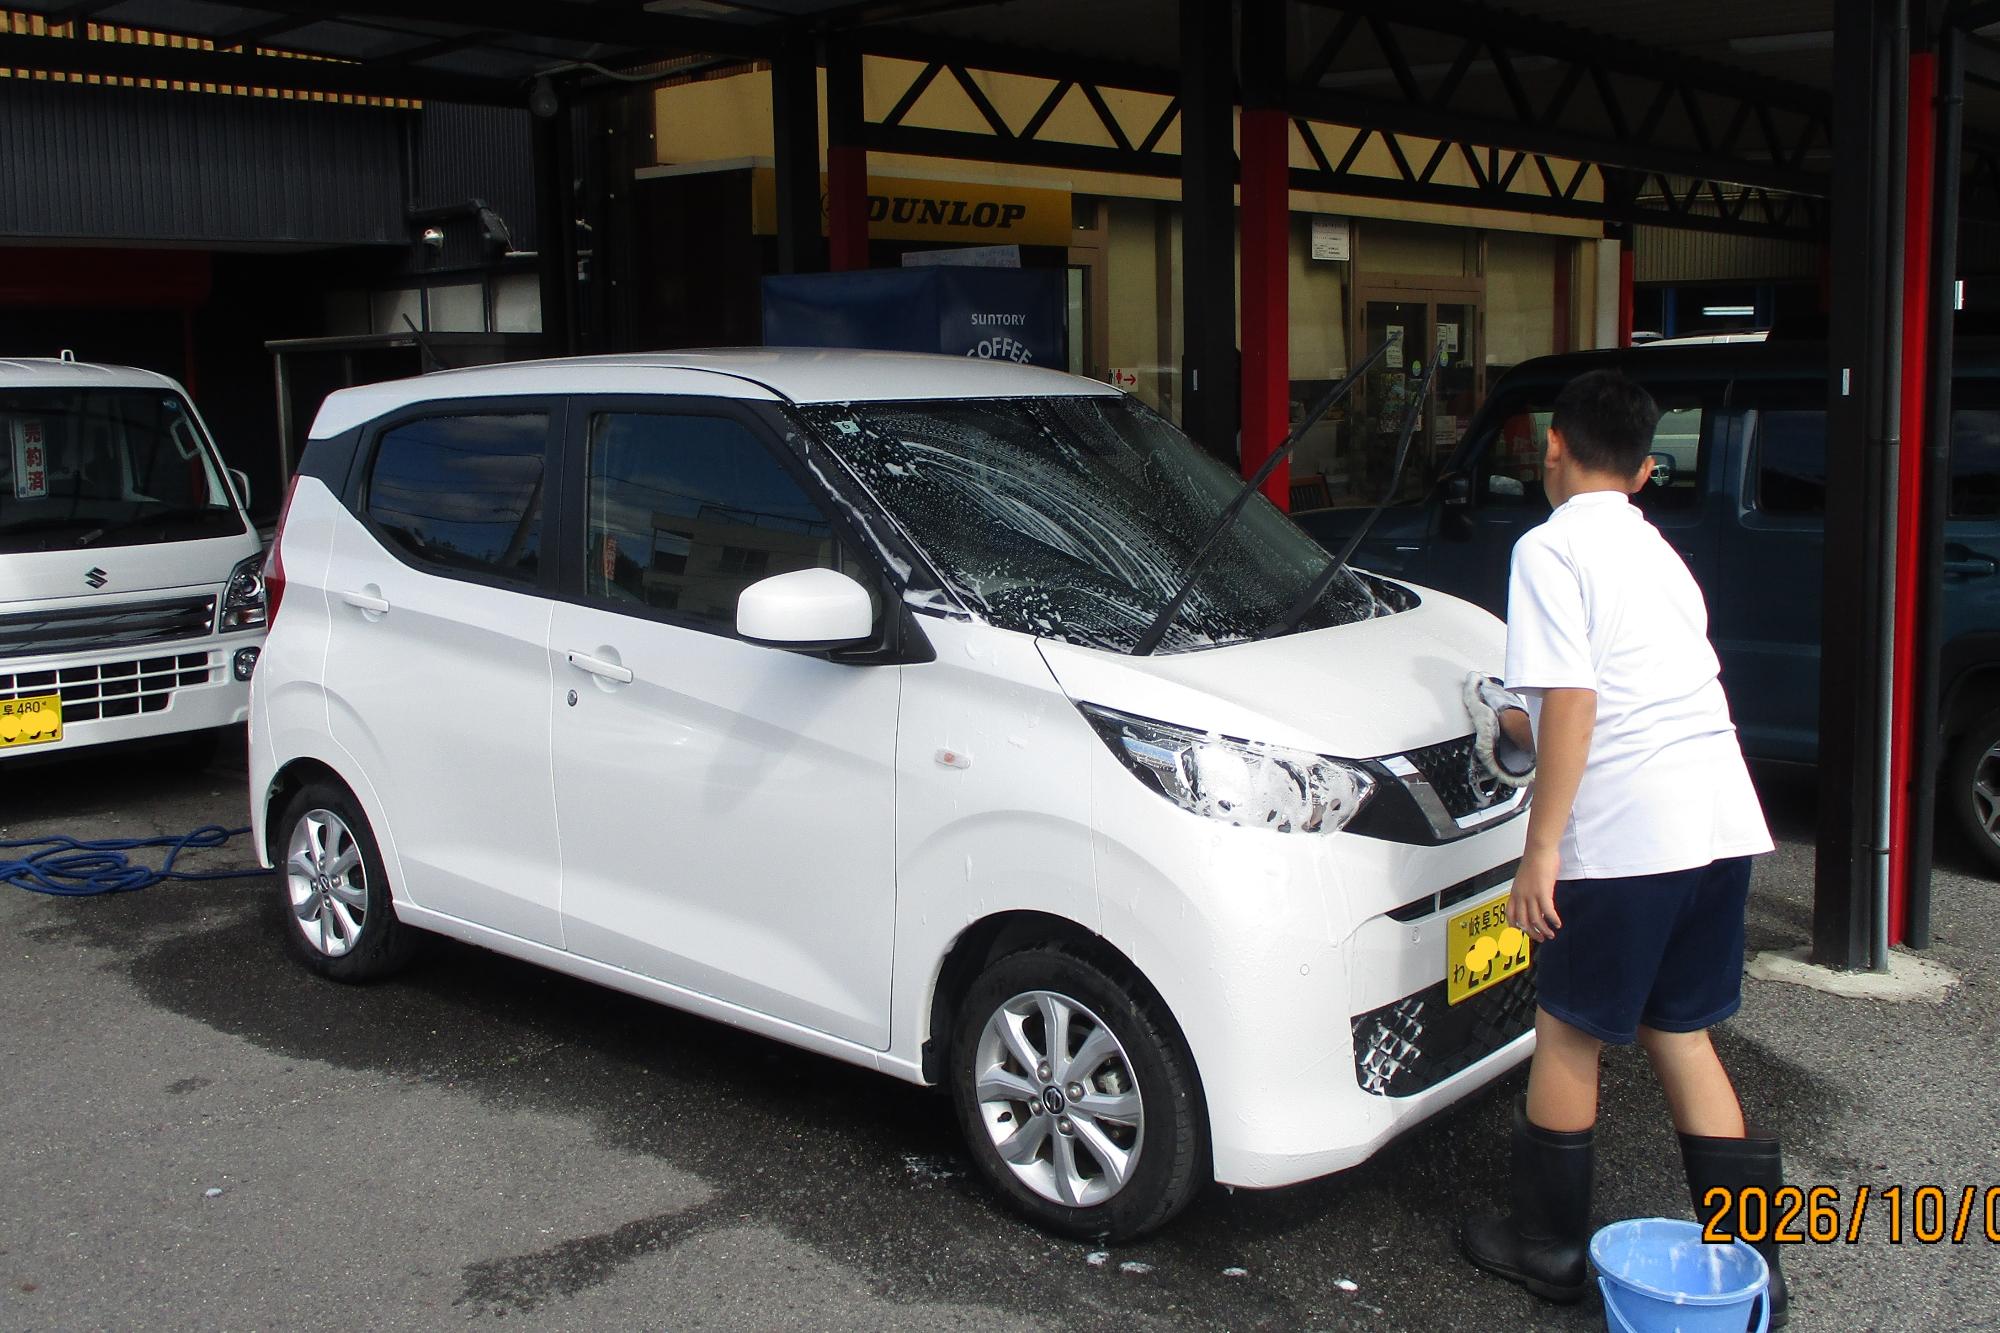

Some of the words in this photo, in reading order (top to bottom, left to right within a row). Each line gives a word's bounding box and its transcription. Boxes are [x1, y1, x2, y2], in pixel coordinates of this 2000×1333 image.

[867, 196, 1026, 229] DUNLOP
[24, 422, 44, 491] 売約済
